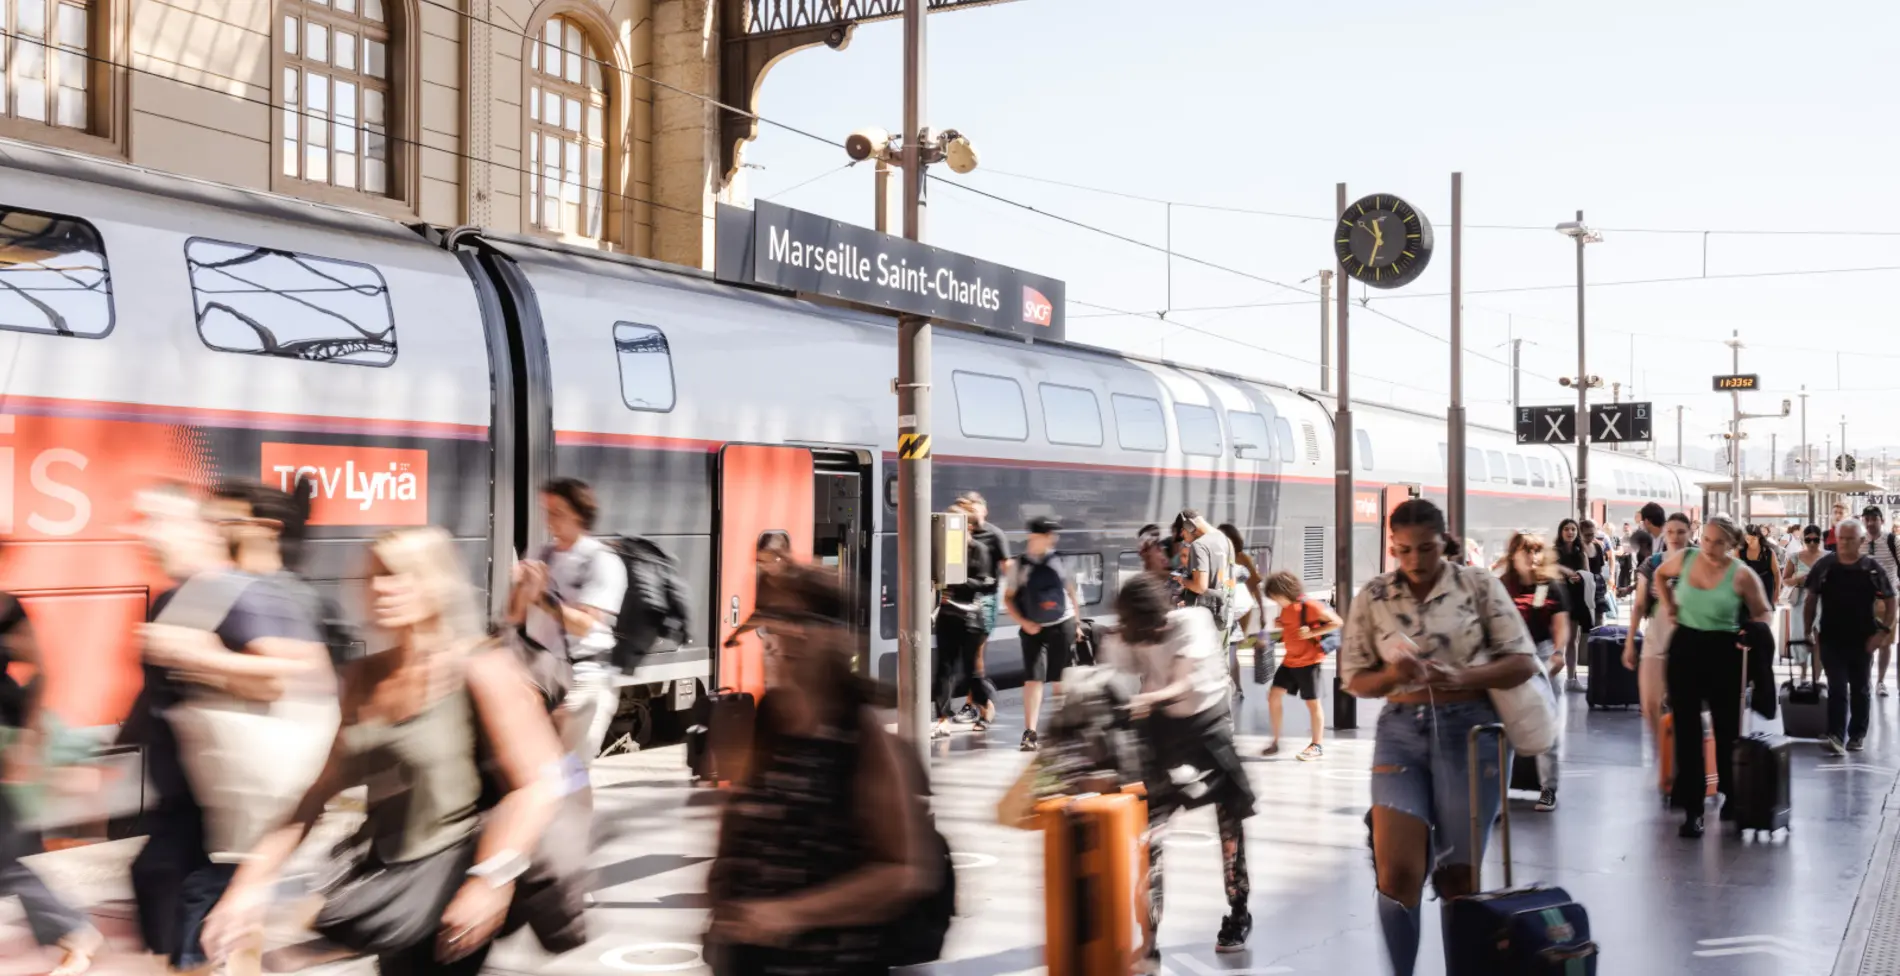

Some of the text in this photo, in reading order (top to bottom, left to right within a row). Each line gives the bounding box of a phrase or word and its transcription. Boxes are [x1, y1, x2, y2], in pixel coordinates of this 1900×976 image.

[768, 225, 1000, 312] Marseille Saint-Charles
[1024, 300, 1051, 321] SNCF
[1544, 414, 1567, 441] X
[1599, 412, 1623, 440] X
[273, 460, 417, 511] TGV Lyria
